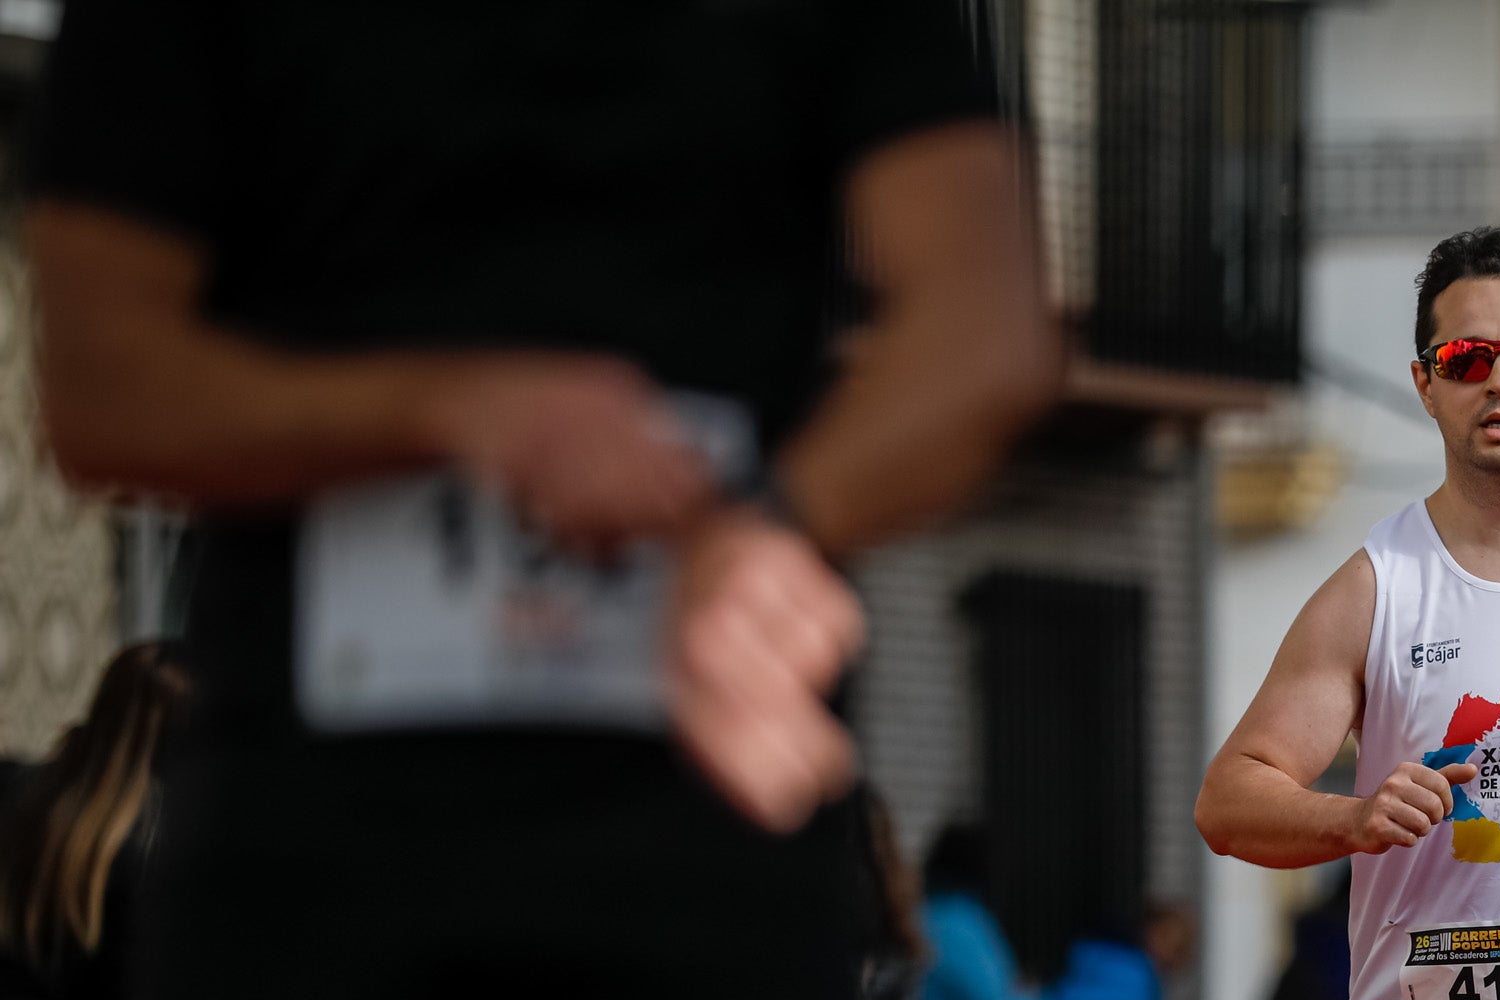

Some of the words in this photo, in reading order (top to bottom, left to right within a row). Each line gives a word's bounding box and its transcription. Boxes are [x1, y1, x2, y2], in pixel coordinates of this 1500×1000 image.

[1426, 646, 1461, 664] Cájar
[1480, 779, 1498, 789] DE
[1416, 935, 1430, 949] 26
[1426, 952, 1435, 961] de
[1436, 952, 1448, 960] los
[1449, 950, 1489, 960] Secaderos
